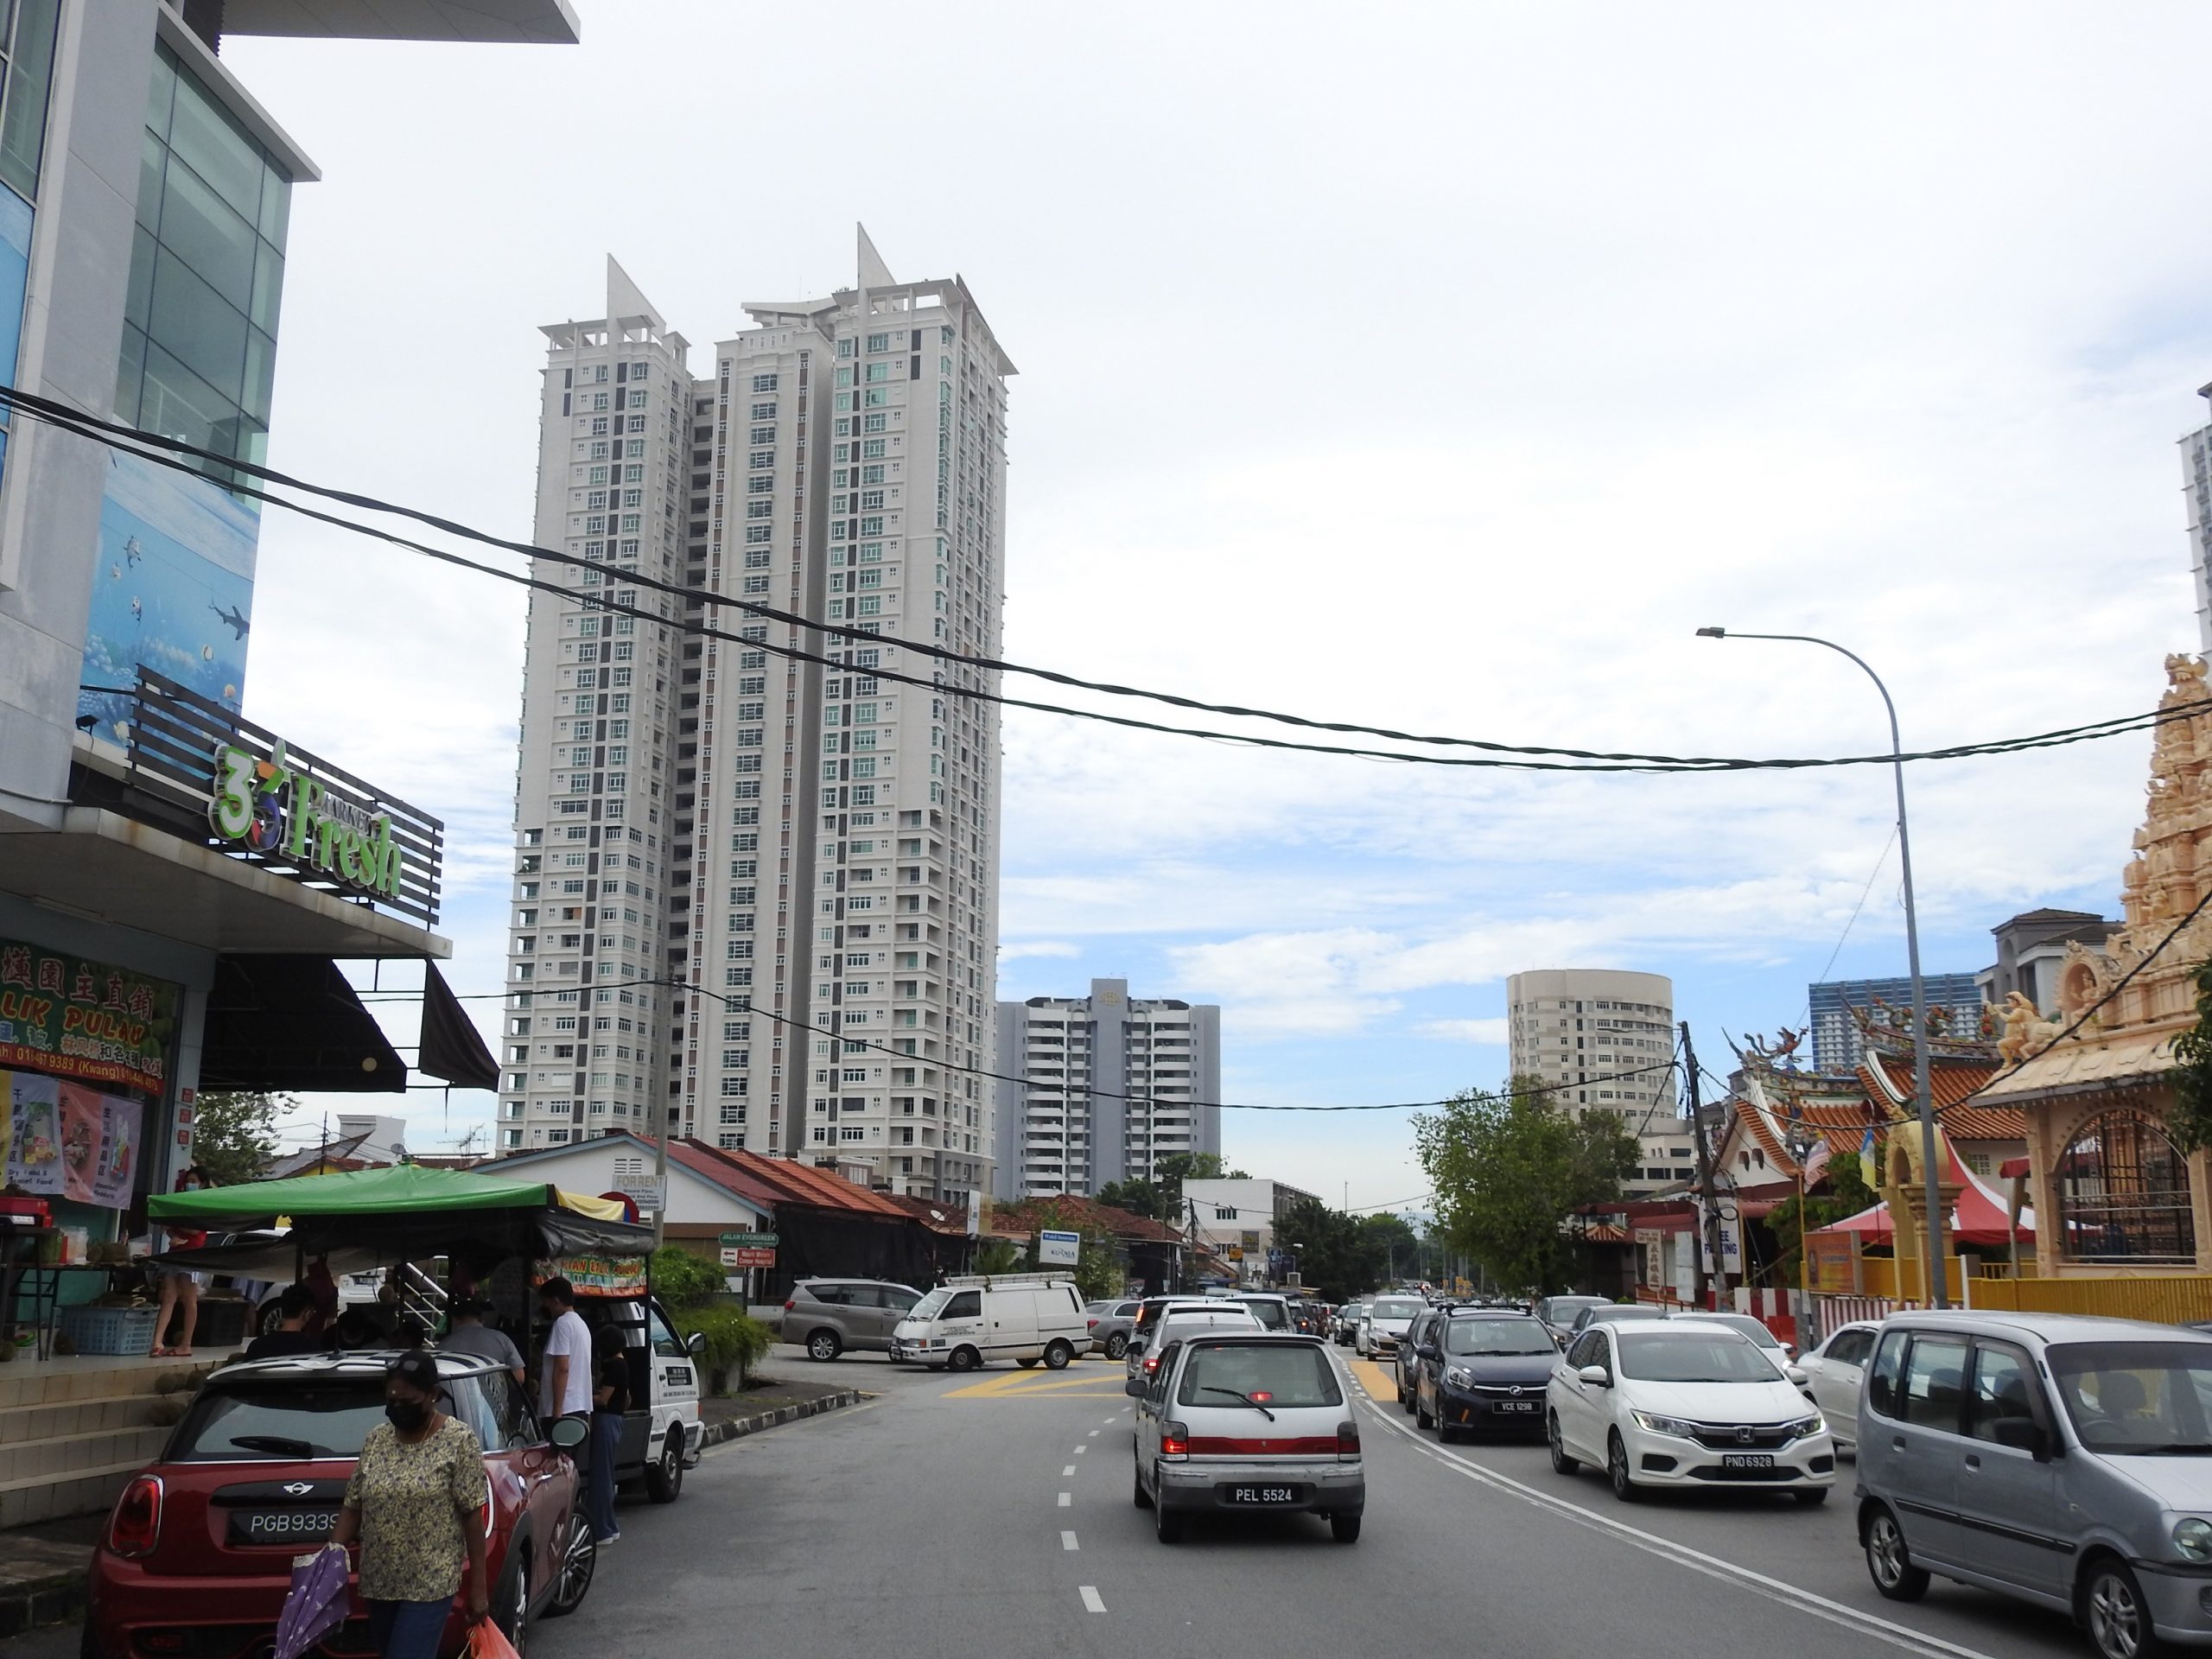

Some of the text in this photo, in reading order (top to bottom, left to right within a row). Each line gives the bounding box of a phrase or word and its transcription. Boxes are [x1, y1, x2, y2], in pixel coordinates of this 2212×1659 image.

[279, 772, 403, 900] Fresh
[63, 1005, 145, 1048] PULAU
[49, 1055, 74, 1071] 9389
[79, 1060, 119, 1078] (Kwang)
[616, 1175, 664, 1187] FOR RENT
[1236, 1489, 1293, 1502] PEL 5524
